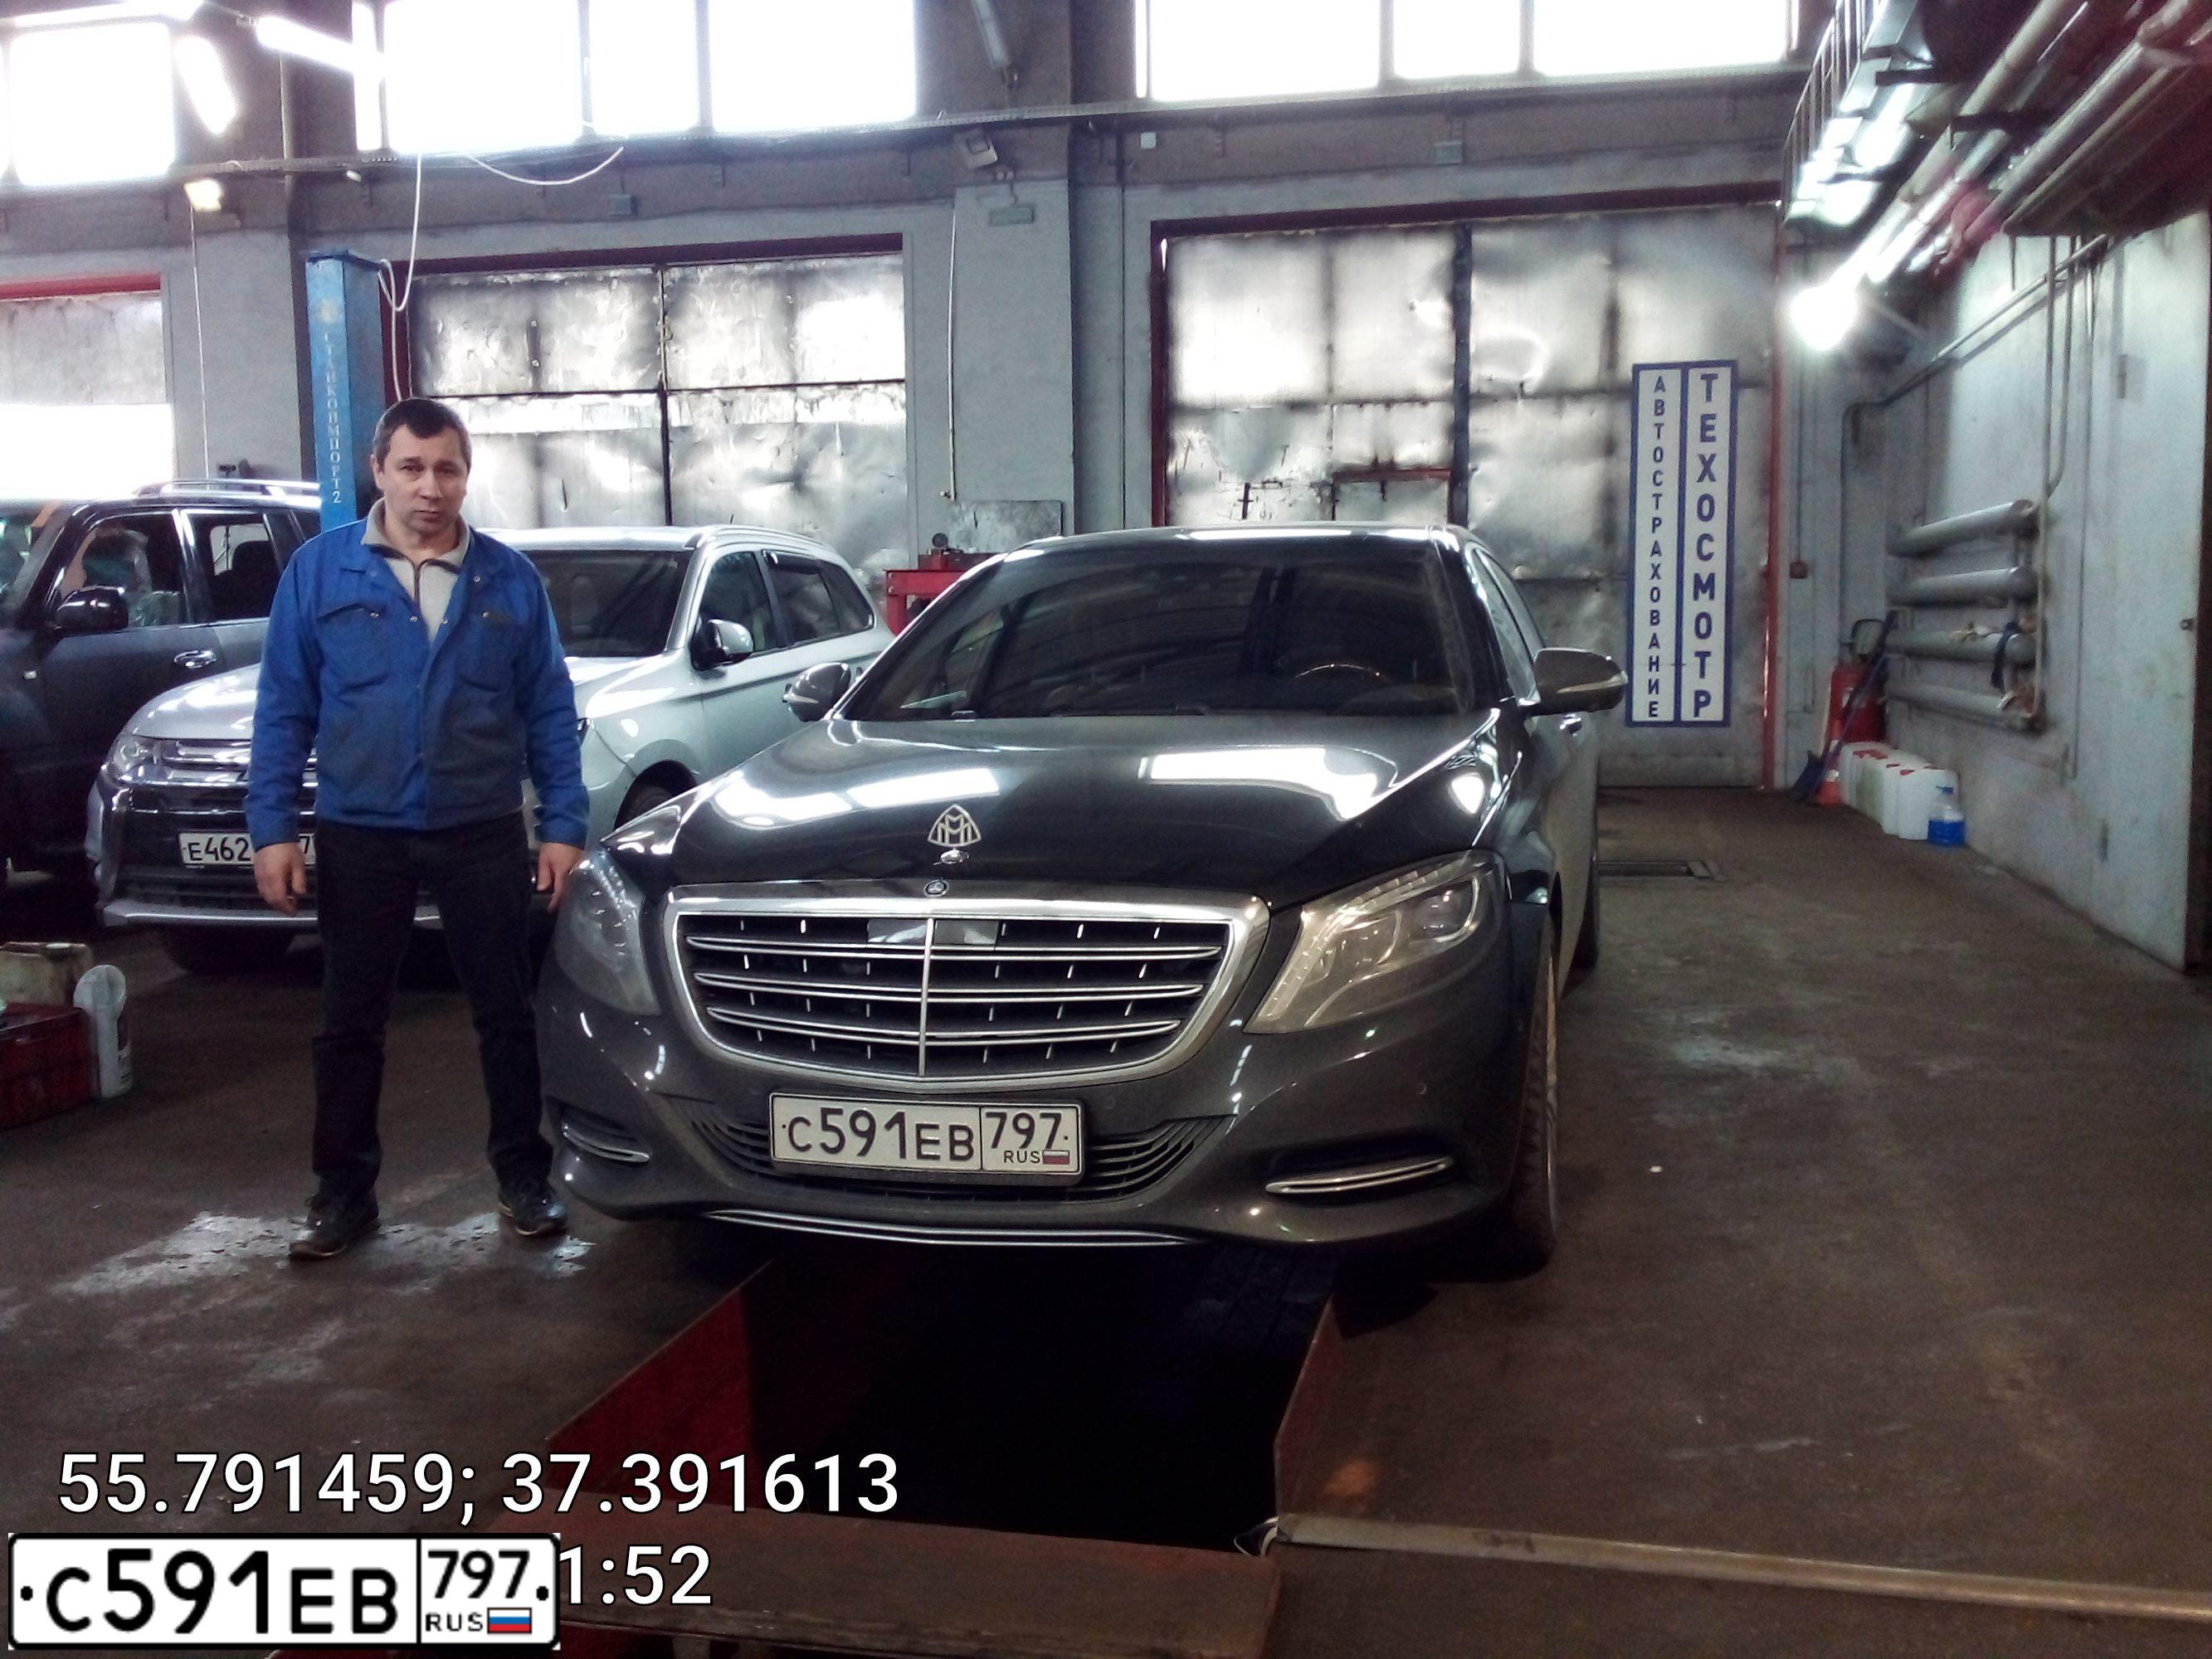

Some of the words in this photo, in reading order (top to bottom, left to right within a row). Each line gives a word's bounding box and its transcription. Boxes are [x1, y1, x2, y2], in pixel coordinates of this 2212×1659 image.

[1648, 376, 1666, 718] АВТОСТРАХОВАНИЕ
[1693, 373, 1719, 718] ТЕХОСМОТР
[188, 836, 252, 862] Е462
[986, 1112, 1063, 1149] 797
[1004, 1151, 1040, 1163] RUS
